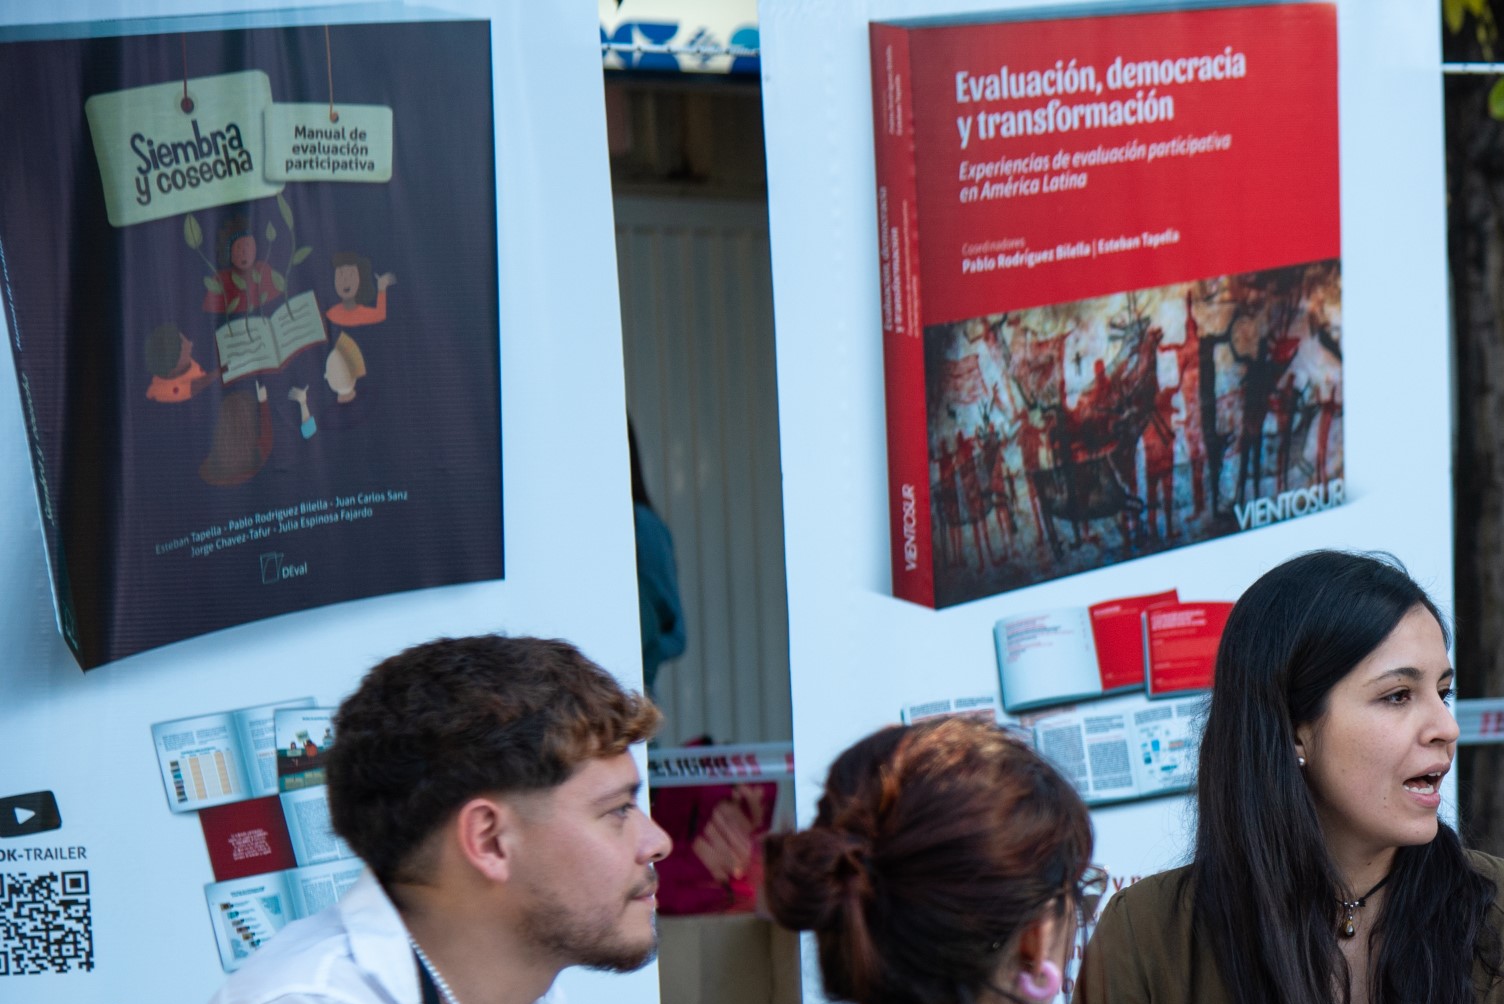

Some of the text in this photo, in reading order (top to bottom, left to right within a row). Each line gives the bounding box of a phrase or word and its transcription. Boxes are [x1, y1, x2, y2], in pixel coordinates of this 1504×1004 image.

[955, 46, 1246, 103] Evaluación, democracia
[294, 125, 367, 141] Manual de
[956, 89, 1174, 149] y transformación
[130, 119, 244, 175] Siembra
[285, 157, 375, 174] participativa
[291, 141, 369, 157] evaluación
[959, 131, 1232, 183] Experiencias de evaluación participativa
[135, 143, 253, 206] y cosecha
[960, 170, 1087, 203] en América Latina
[190, 525, 222, 543] Tapella
[229, 516, 253, 531] Pablo
[358, 493, 385, 505] Carlos
[387, 490, 408, 502] Sanz
[1234, 481, 1345, 531] VIENTOSUR
